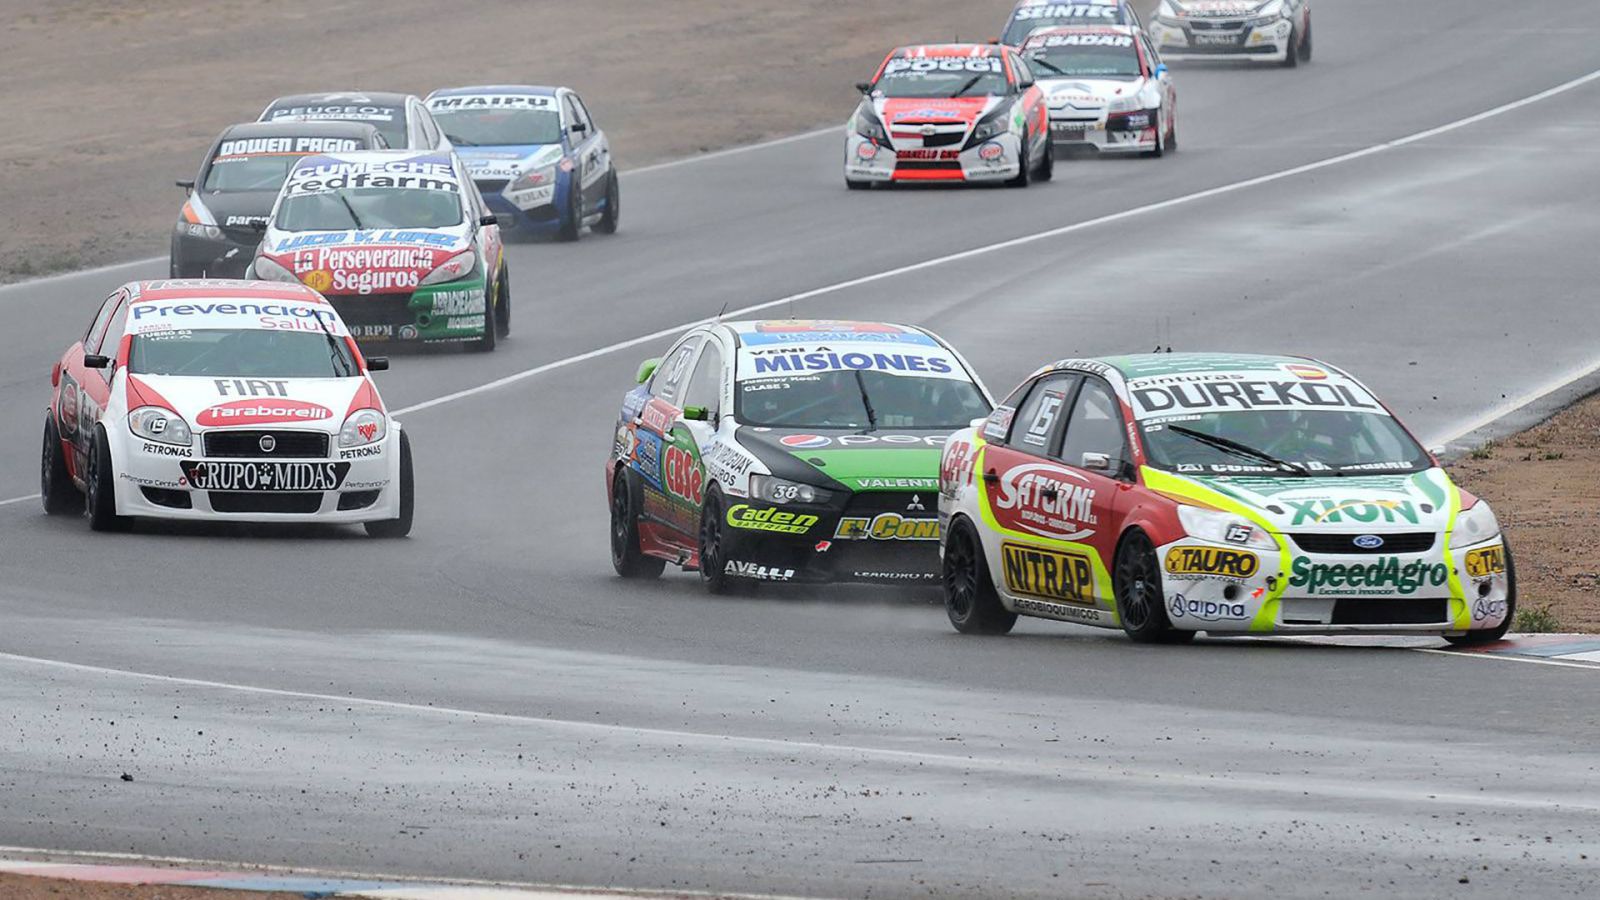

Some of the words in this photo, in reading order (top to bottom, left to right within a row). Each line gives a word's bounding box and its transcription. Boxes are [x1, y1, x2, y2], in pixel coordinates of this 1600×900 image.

[1014, 5, 1118, 20] SEINTEC
[886, 59, 1002, 73] POGGI
[432, 97, 549, 108] MAIPU
[273, 106, 395, 118] PEUGEOT
[220, 138, 292, 157] DOWEN
[293, 161, 455, 179] CUMECHE
[286, 173, 460, 194] redfarm
[379, 230, 461, 248] LOPEZ
[293, 249, 314, 274] La
[318, 247, 434, 272] Perseverancia
[333, 269, 420, 295] Seguros
[134, 303, 337, 321] Prevención
[260, 316, 337, 334] Salud
[364, 324, 393, 336] RPM
[748, 347, 806, 356] VENI
[754, 352, 952, 374] MISIONES
[214, 379, 289, 397] FIAT
[744, 383, 780, 392] CLASE
[1132, 374, 1246, 389] pinturas
[1130, 381, 1378, 413] DUREKOL
[208, 403, 328, 419] Taraborelli
[152, 419, 168, 434] 19
[142, 442, 193, 458] PETRONAS
[339, 445, 382, 459] PETRONAS
[194, 462, 259, 490] GRUPO
[273, 462, 337, 491] MIDAS
[773, 485, 799, 499] 38
[727, 504, 819, 527] Caden
[1284, 499, 1421, 526] XION
[872, 515, 941, 538] CON
[1226, 527, 1252, 544] 15
[1181, 549, 1256, 576] TAURO
[1005, 547, 1090, 601] NITRAP
[1289, 555, 1449, 595] SpeedAgro
[1013, 598, 1101, 621] AGROBIOQUIMICOS
